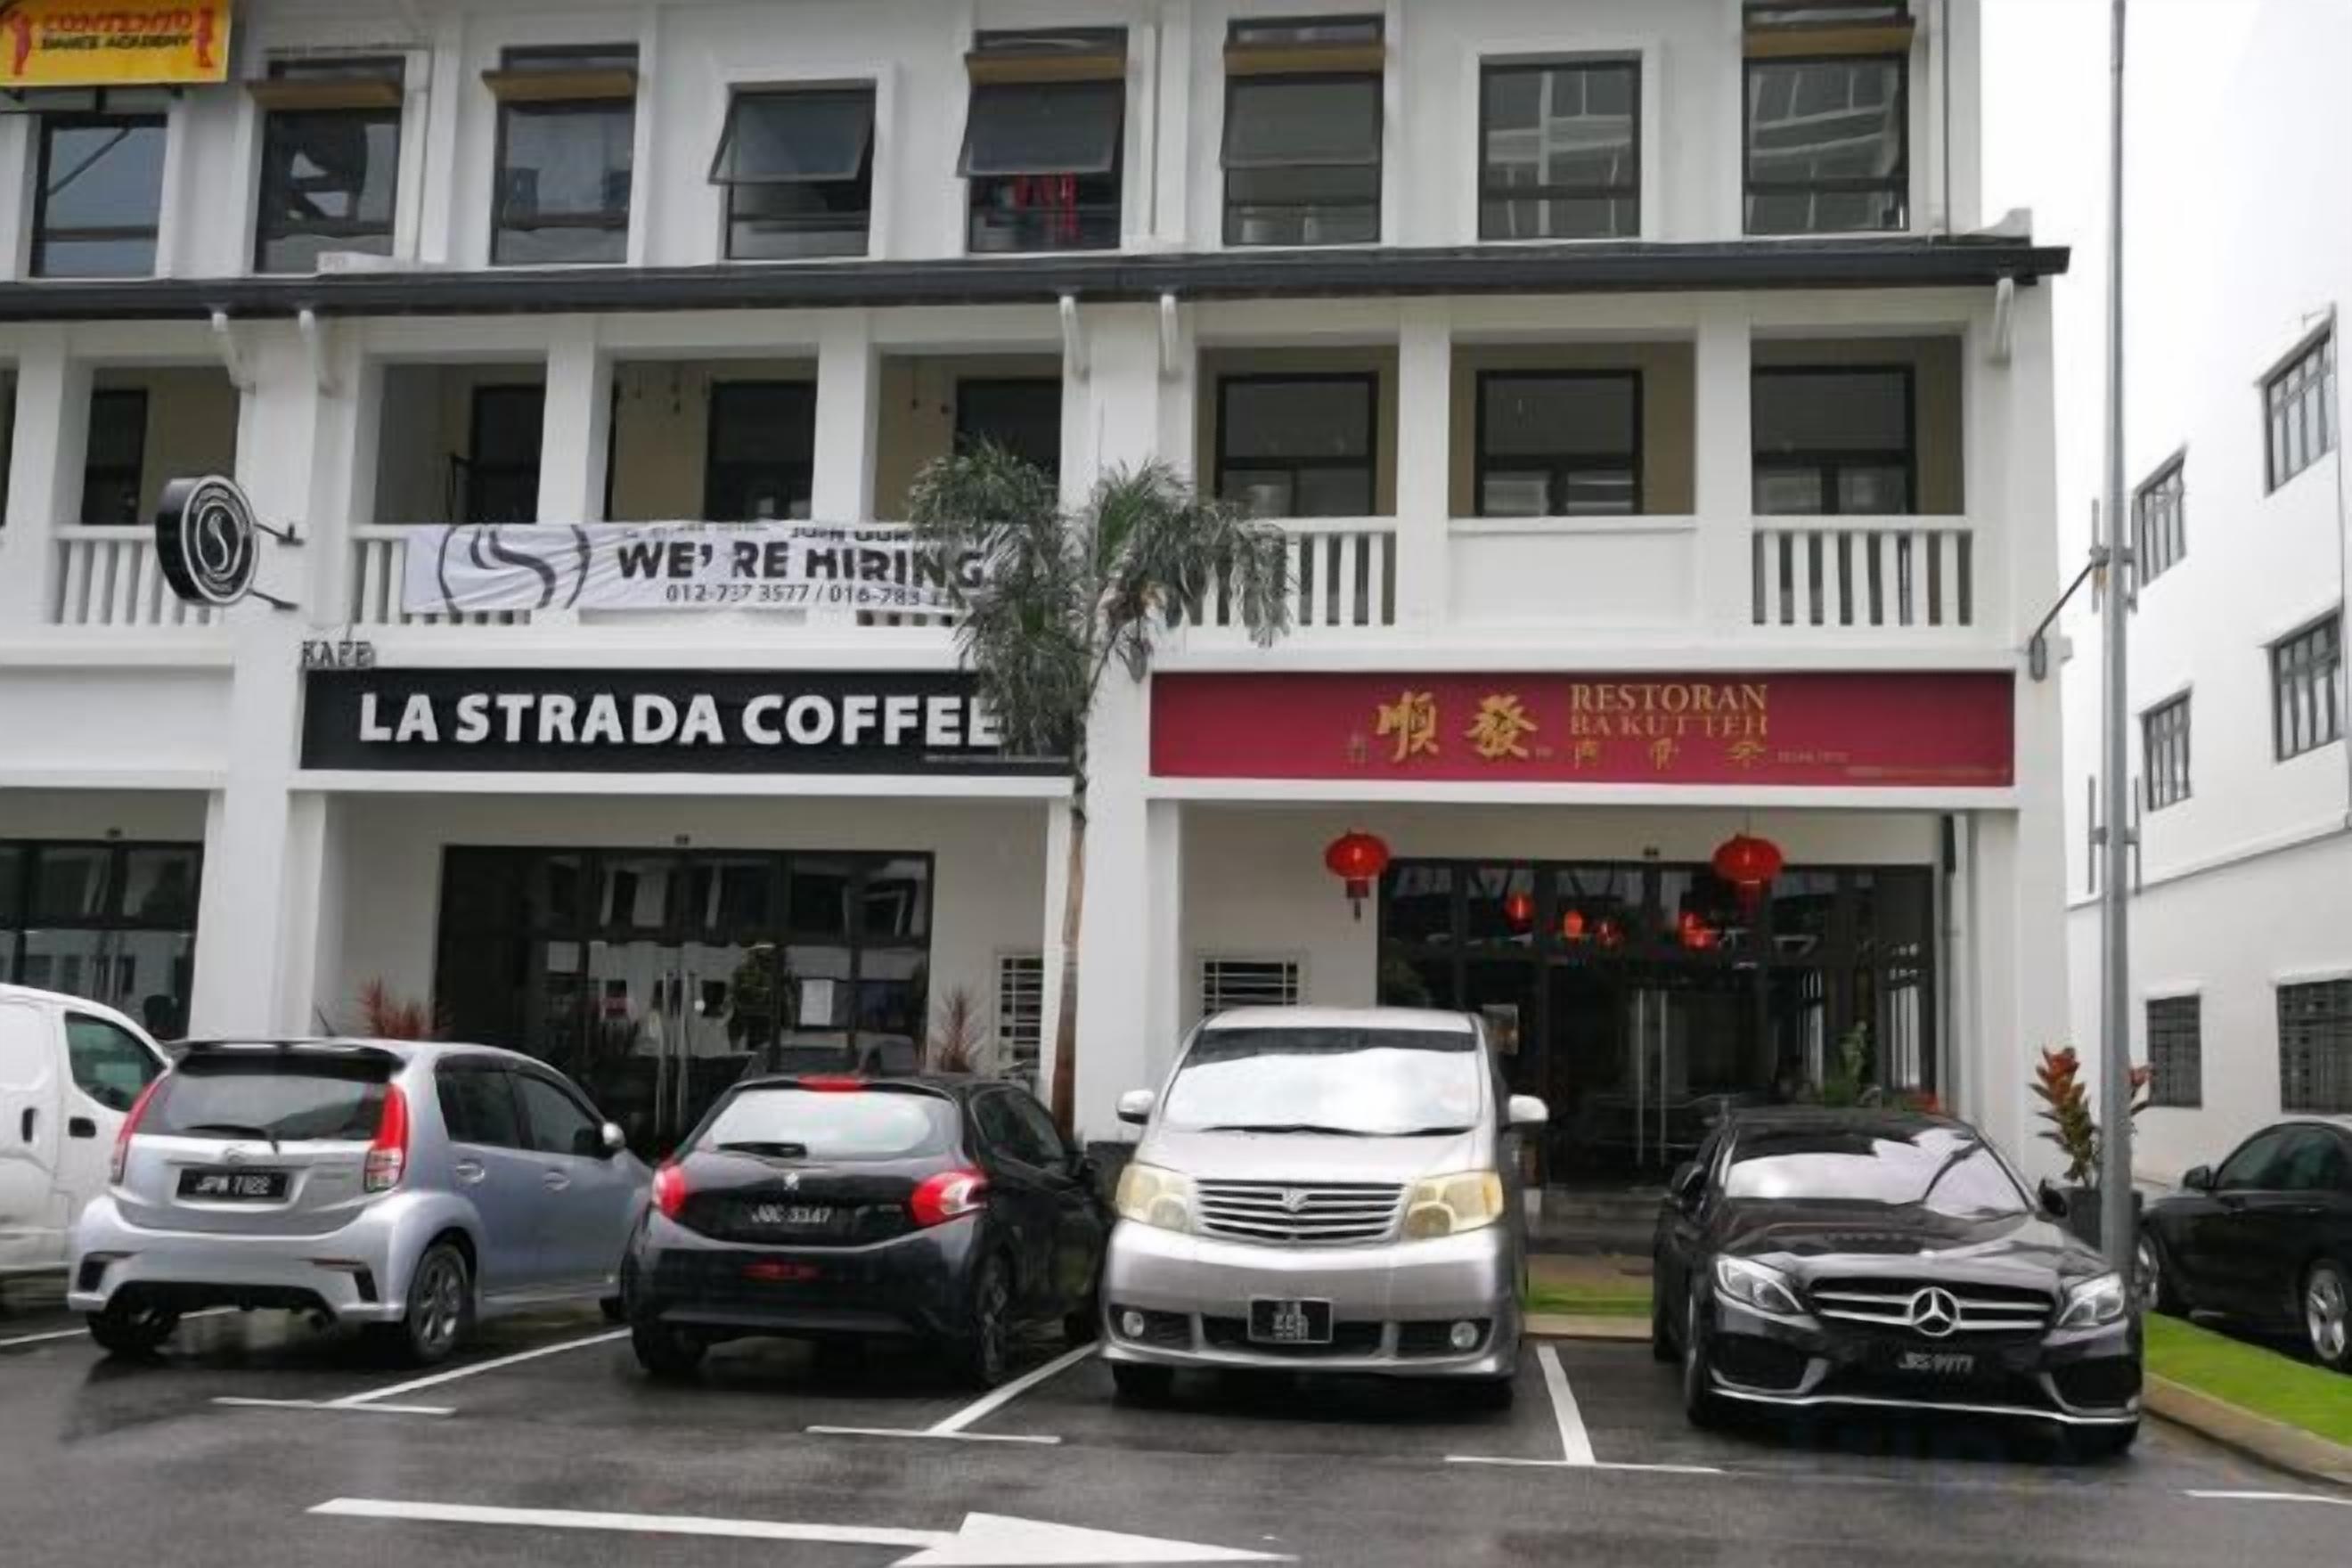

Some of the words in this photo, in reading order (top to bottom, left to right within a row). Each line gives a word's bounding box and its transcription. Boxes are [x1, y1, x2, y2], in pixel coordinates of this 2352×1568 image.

[805, 548, 985, 589] HIRING
[1570, 683, 1768, 712] RESTORAN
[359, 693, 439, 742] LA
[455, 693, 725, 744] STRADA
[741, 694, 1003, 747] COFFEE
